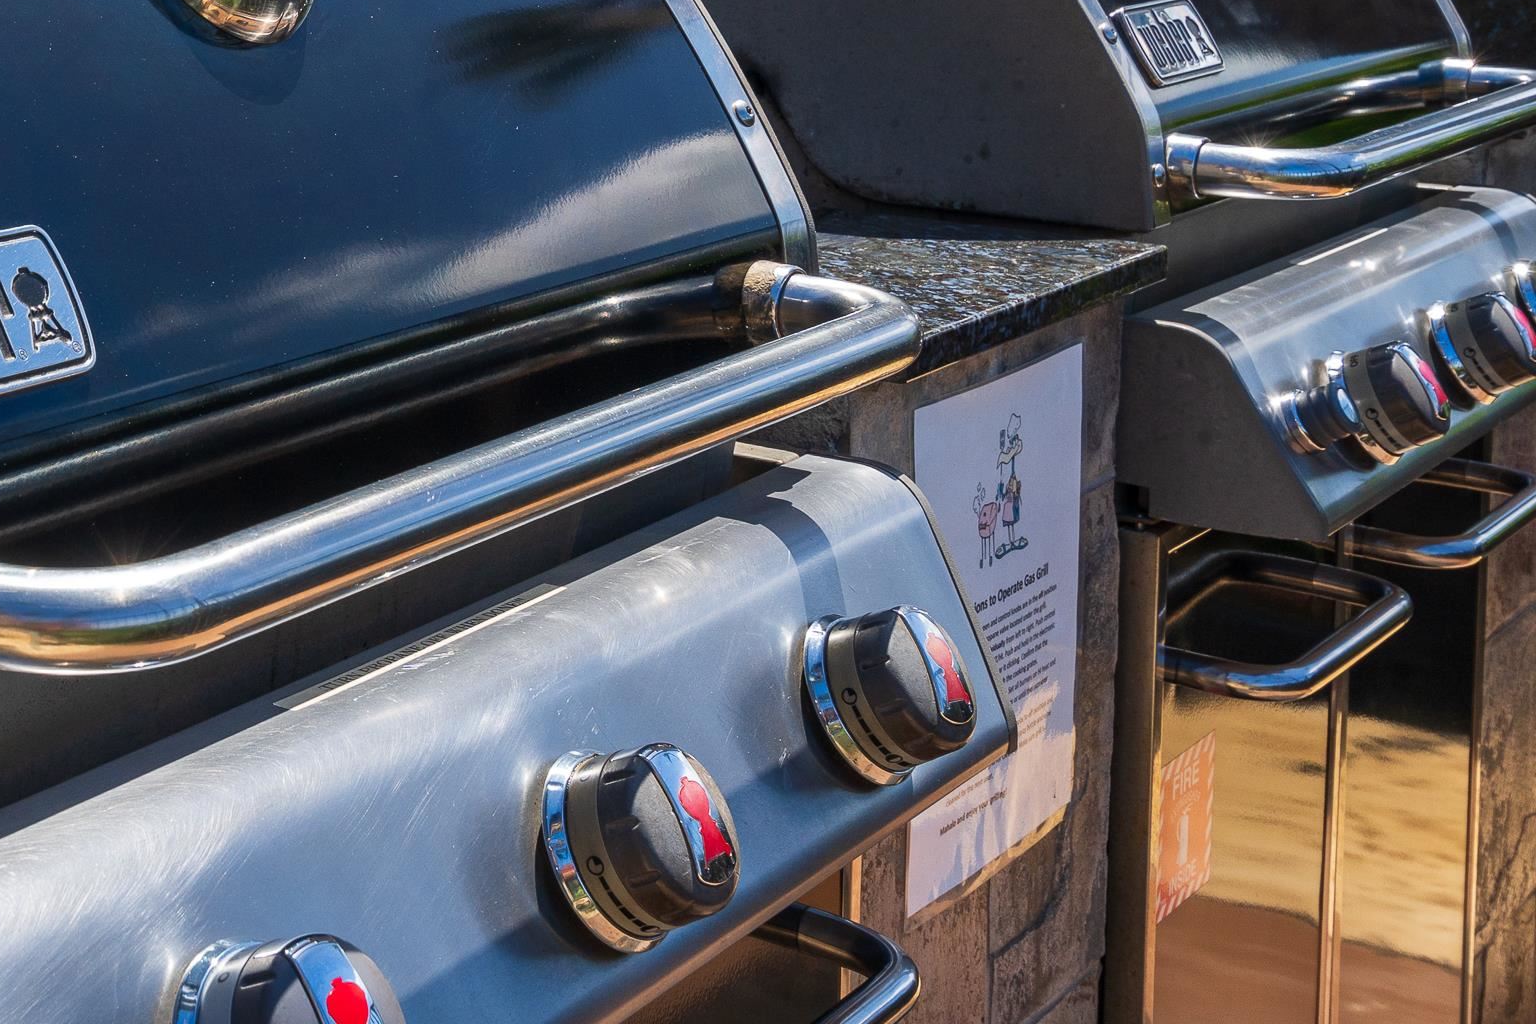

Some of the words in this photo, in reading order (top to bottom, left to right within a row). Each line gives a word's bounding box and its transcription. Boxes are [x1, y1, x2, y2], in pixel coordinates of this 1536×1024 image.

[989, 595, 997, 606] to
[997, 580, 1024, 602] Operate
[1024, 574, 1035, 587] Gas
[1036, 562, 1049, 580] Grill
[1172, 759, 1201, 801] FIRE
[1168, 858, 1198, 896] INSIDE
